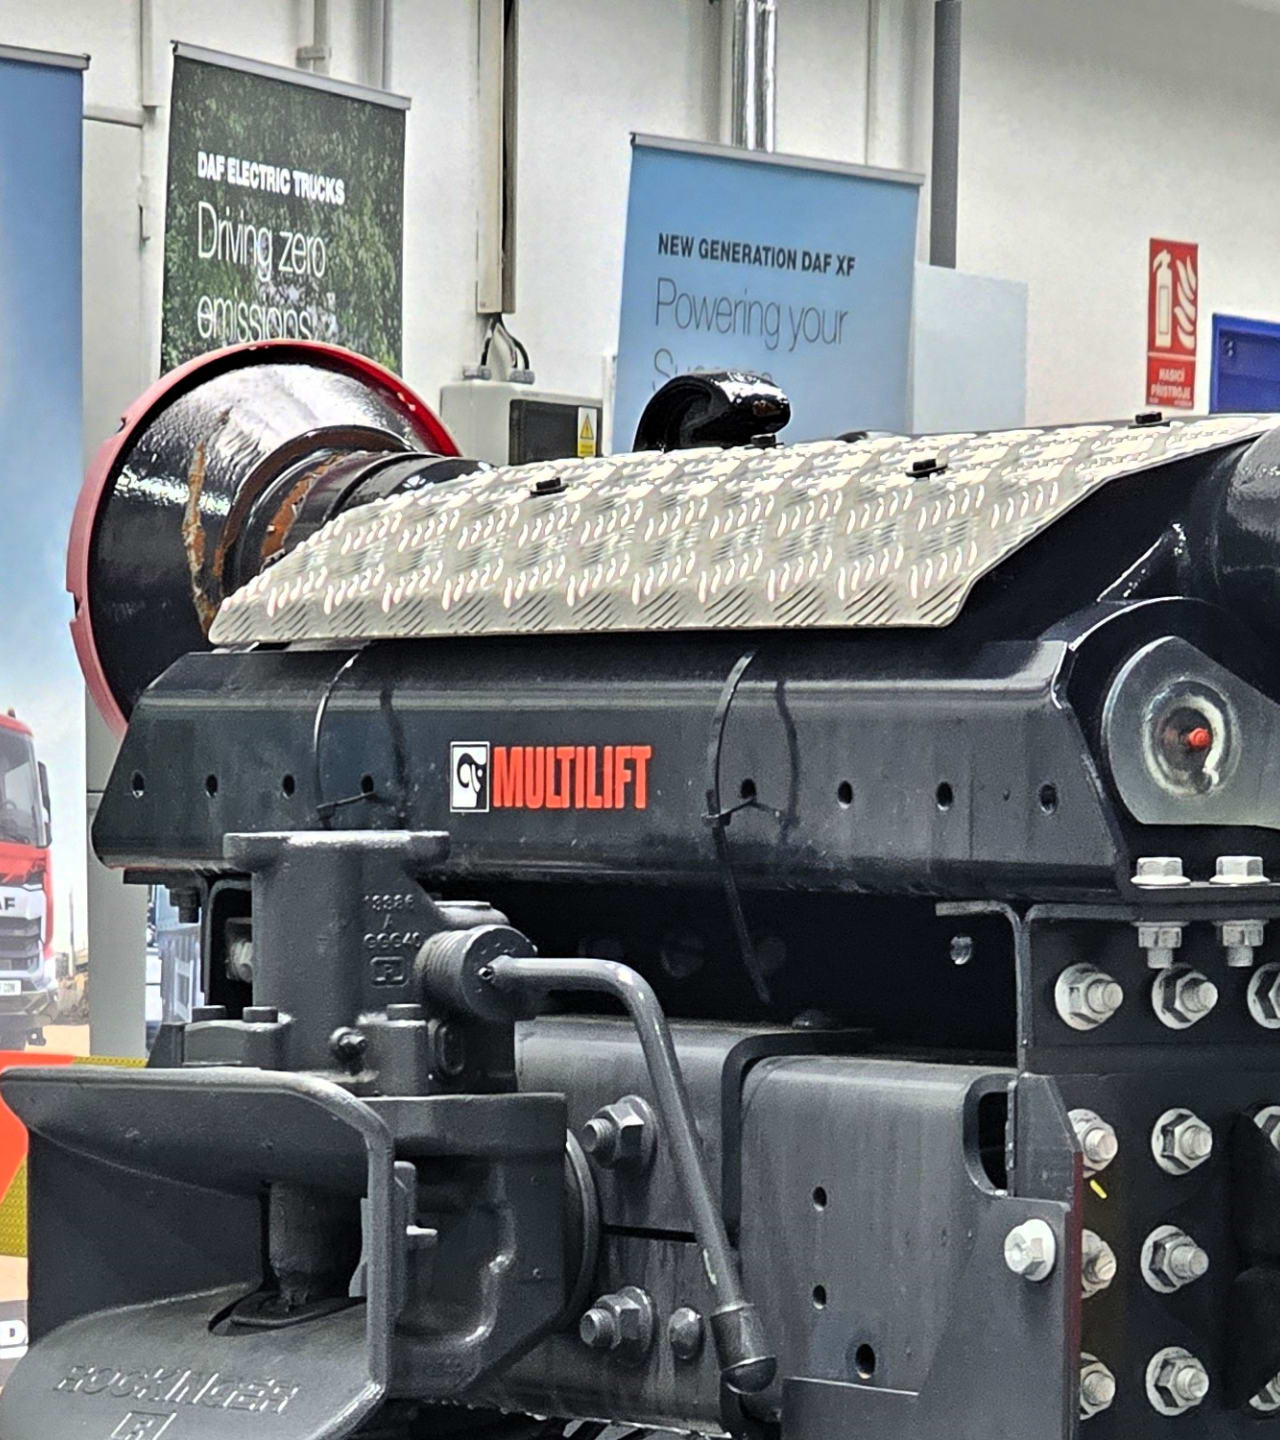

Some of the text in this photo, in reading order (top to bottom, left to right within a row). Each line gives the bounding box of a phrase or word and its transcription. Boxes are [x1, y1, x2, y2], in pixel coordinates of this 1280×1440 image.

[198, 151, 345, 205] DAF ELECTRIC TRUCKS
[198, 201, 326, 282] Driving zero
[658, 232, 856, 277] NEW GENERATION DAF XF
[197, 295, 314, 341] emissions
[655, 277, 848, 352] Powering your
[493, 745, 652, 808] MULTILIFT
[53, 1365, 301, 1415] ROCKINGER
